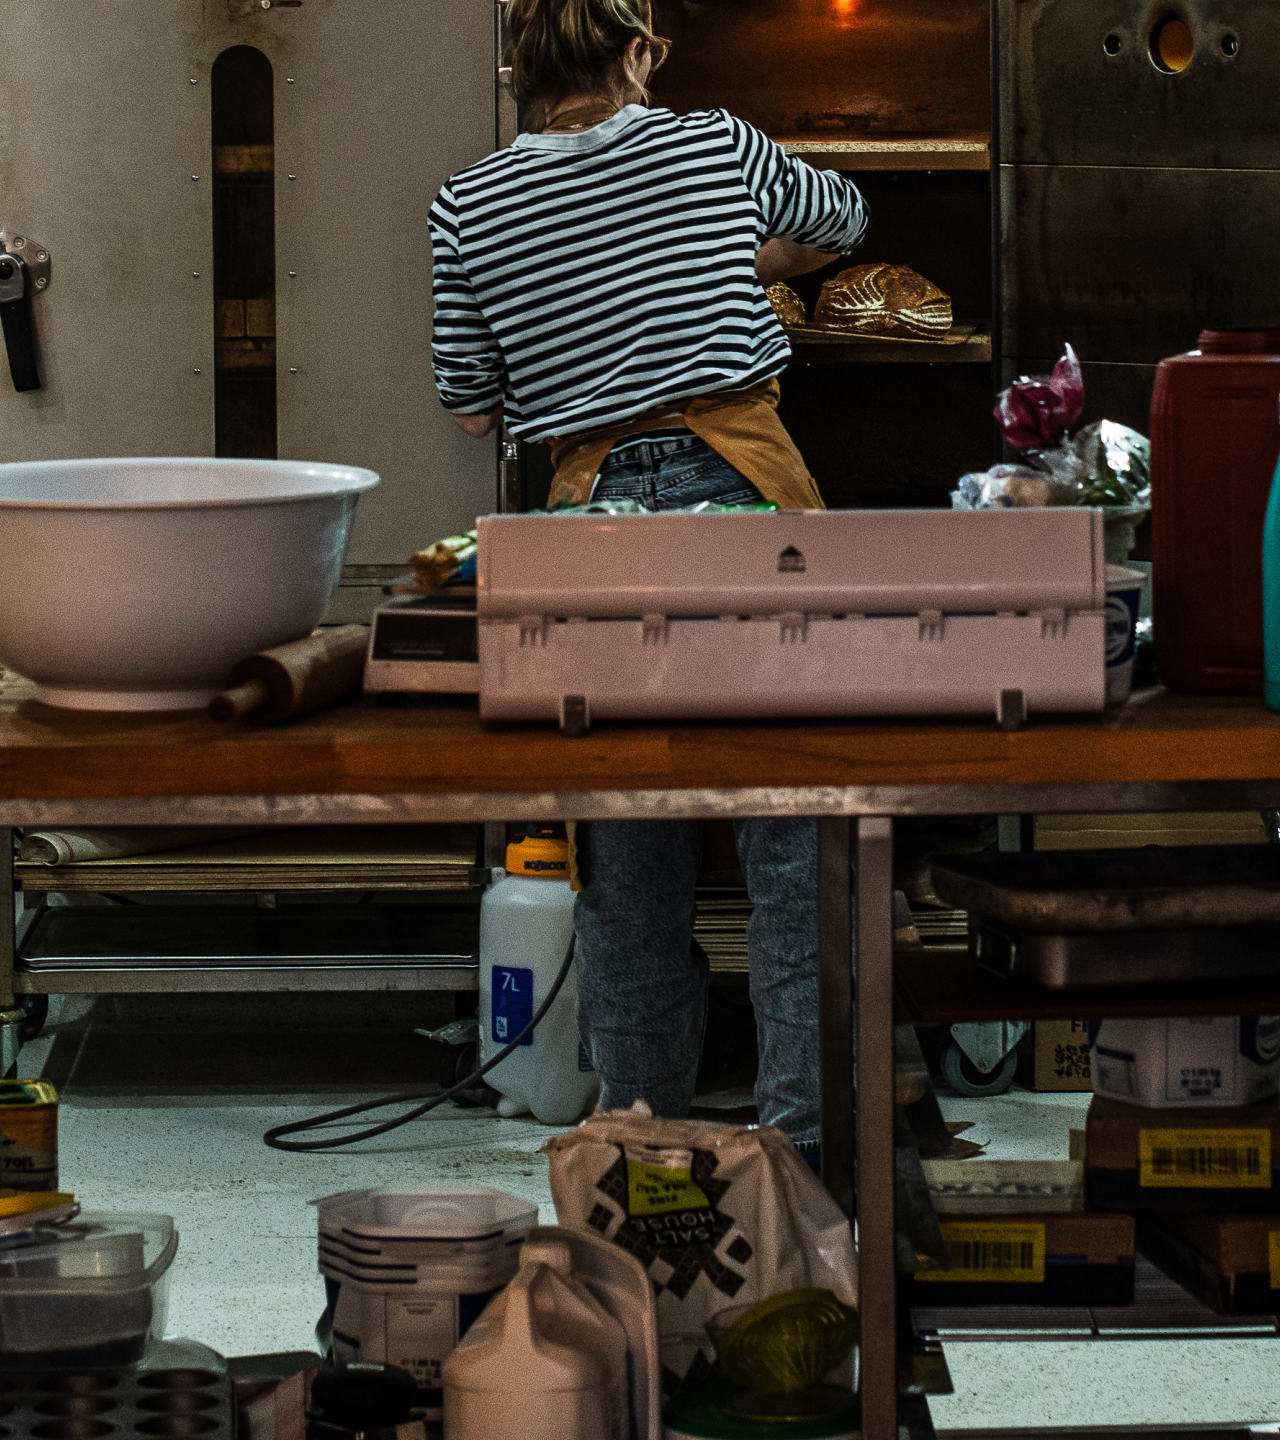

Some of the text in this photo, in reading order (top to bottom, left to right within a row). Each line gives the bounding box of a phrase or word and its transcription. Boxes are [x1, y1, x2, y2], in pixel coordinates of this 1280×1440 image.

[500, 971, 521, 992] 7L
[630, 1210, 716, 1233] HOUSE
[654, 1227, 712, 1246] SALT
